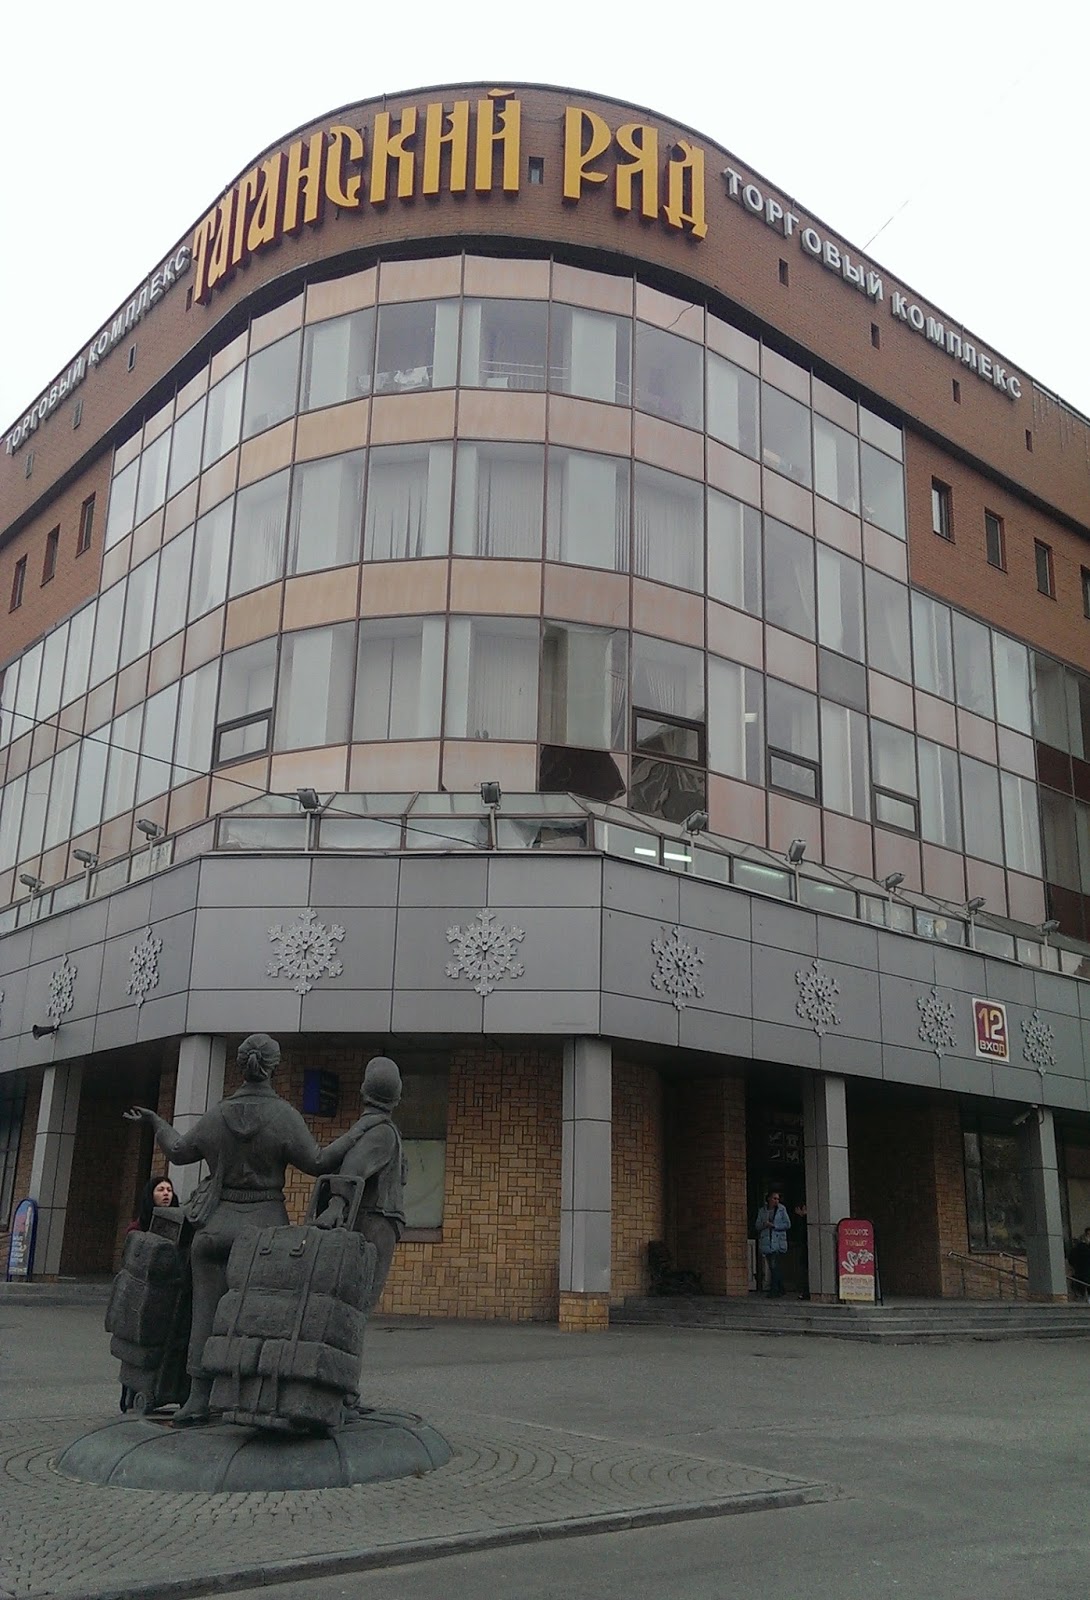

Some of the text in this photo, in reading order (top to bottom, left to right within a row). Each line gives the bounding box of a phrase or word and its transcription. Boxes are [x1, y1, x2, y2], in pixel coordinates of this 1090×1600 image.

[192, 88, 709, 304] ТАГАНСКИЙ РЯД
[723, 166, 1022, 400] ТОРГОВЫЙ КОМПЛЕКС
[5, 245, 192, 455] ТОРГОВЫЙ КОМПЛЕКС
[978, 1007, 1004, 1041] 12
[979, 1040, 1006, 1056] ВХОД
